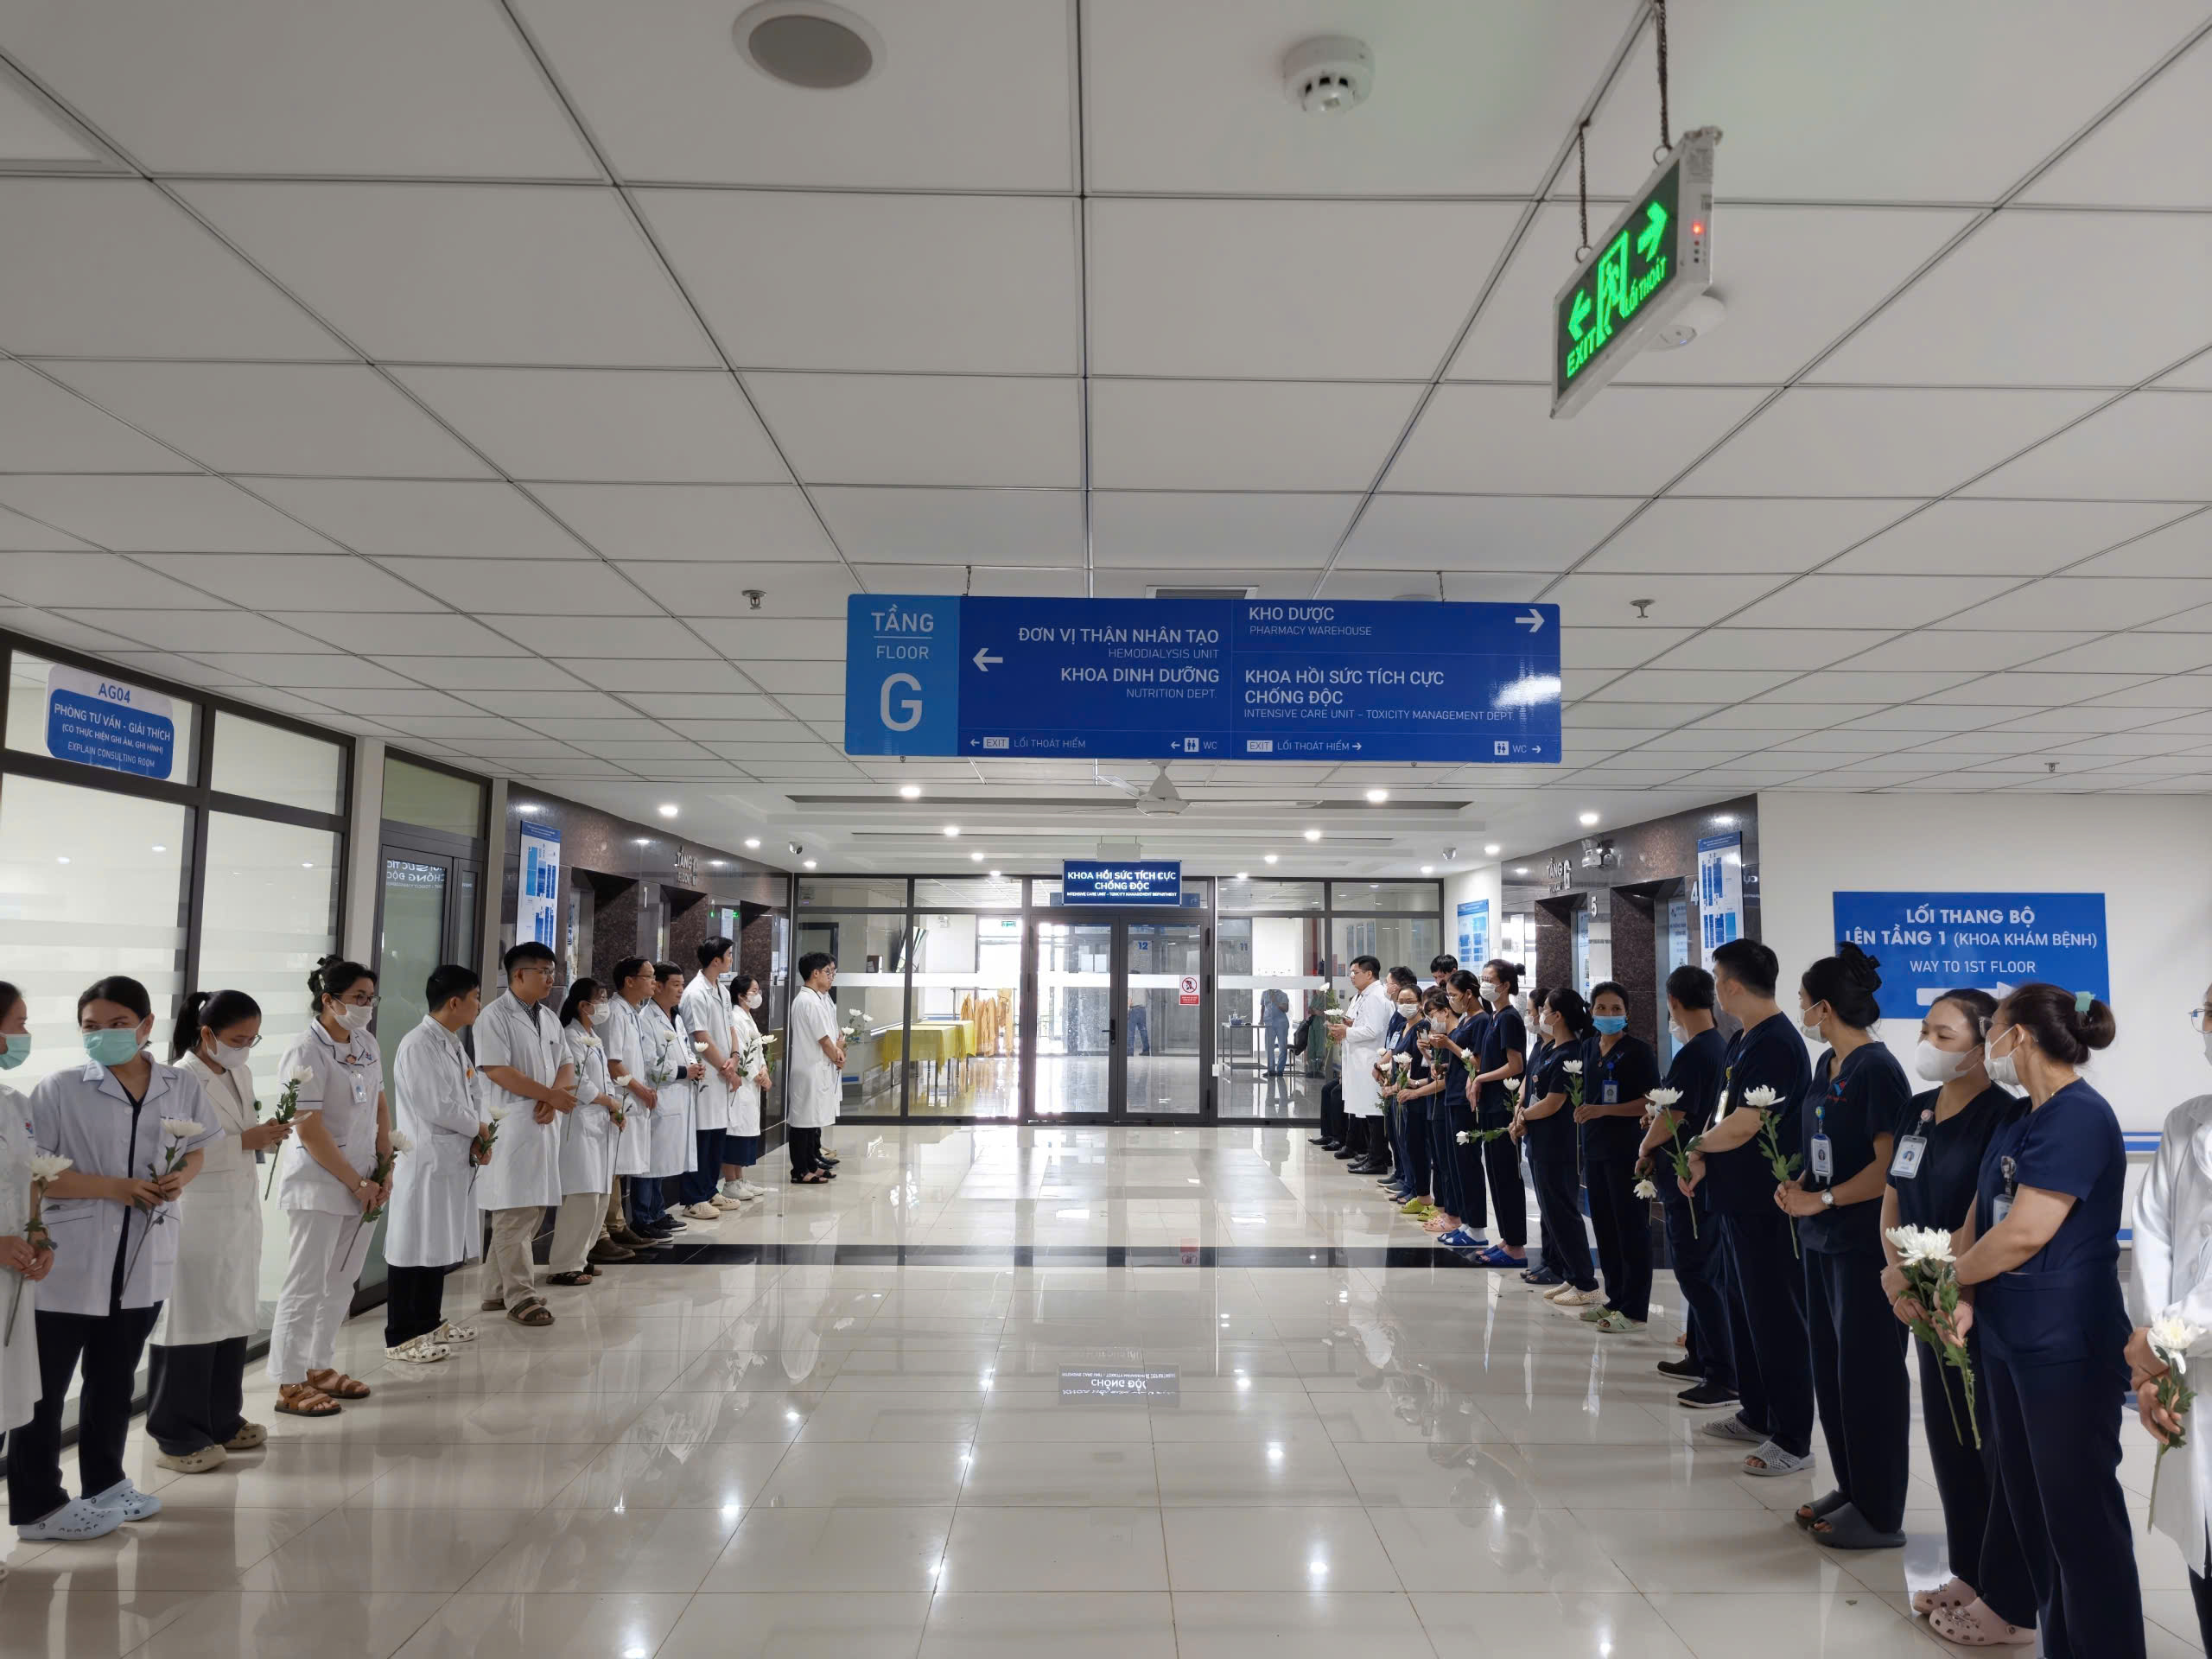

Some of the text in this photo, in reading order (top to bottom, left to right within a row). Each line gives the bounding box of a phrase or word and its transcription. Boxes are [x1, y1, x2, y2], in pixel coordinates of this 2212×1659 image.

[1567, 326, 1597, 378] EXIT
[871, 604, 933, 632] TẦNG
[1249, 607, 1334, 623] KHO DƯỢC
[1019, 626, 1218, 645] ĐƠN VỊ THẬN NHÂN TẠO
[1250, 626, 1372, 636] PHARMACY WAREHOUSE
[876, 645, 929, 659] FLOOR
[1109, 648, 1219, 658] HEMODIALYSIS UNIT
[1061, 666, 1219, 683] KHOA DINH DƯỠNG
[1245, 666, 1444, 688] KHOA HỒI SỨC TÍCH CỰC
[99, 683, 130, 703] AG04
[880, 673, 922, 731] G
[1127, 689, 1217, 699] NUTRITION DEPT.
[1245, 686, 1344, 707] CHỐNG ĐỘC
[54, 703, 86, 721] PHÒNG
[90, 712, 102, 724] TƯ
[104, 715, 121, 729] VẤN
[147, 727, 170, 741] THÍCH
[1244, 709, 1297, 718] INTENSIVE
[1300, 709, 1327, 718] CARE
[1331, 709, 1355, 719] UNIT
[1367, 709, 1409, 719] TOXICITY
[1413, 710, 1484, 721] MANAGEMENT
[1487, 711, 1515, 721] DEPT.
[111, 735, 122, 744] GHI
[135, 741, 146, 750] GHI
[987, 739, 1006, 747] EXIT
[1014, 736, 1028, 747] LỐI
[1031, 738, 1060, 747] THOÁT
[1250, 741, 1269, 750] EXIT
[1277, 740, 1292, 750] LỐI
[1294, 741, 1324, 751] THOÁT
[68, 742, 155, 767] EXPLAIN CONSULTING ROOM
[1115, 869, 1133, 880] SỨC
[1134, 869, 1156, 880] TÍCH
[1157, 871, 1176, 880] CỰC
[1094, 880, 1149, 891] CHỐNG ĐỘC
[1691, 881, 1699, 906] 4
[1591, 896, 1598, 918] 5
[1906, 903, 2035, 928] LỐI THANG BỘ
[1846, 923, 2097, 949] LÊN TẦNG 1 (KHOA KHÁM BỆNH)
[1910, 960, 2036, 973] WAY TO 1ST FLOOR
